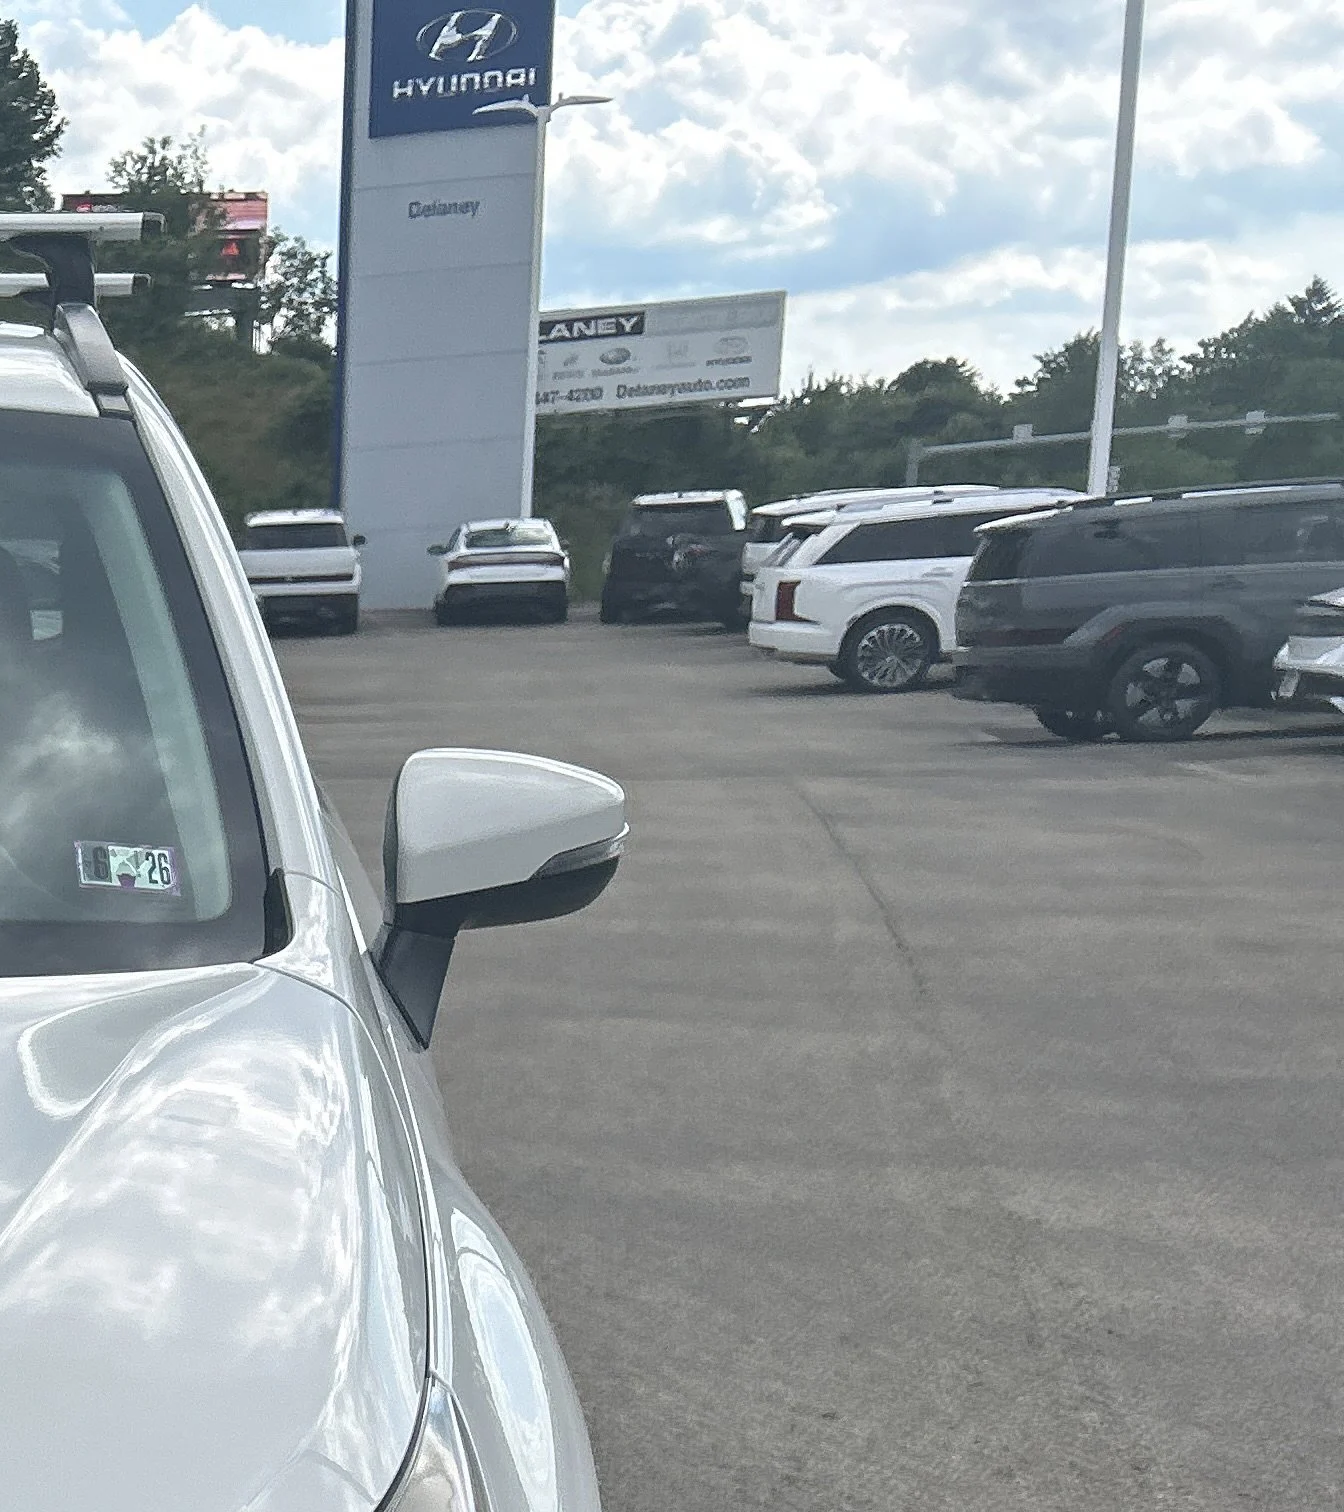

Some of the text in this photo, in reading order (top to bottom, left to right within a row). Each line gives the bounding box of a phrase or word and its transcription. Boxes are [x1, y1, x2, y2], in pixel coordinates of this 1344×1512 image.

[392, 67, 537, 100] HYUNDAI
[408, 199, 481, 219] Delaney
[145, 851, 172, 884] 26
